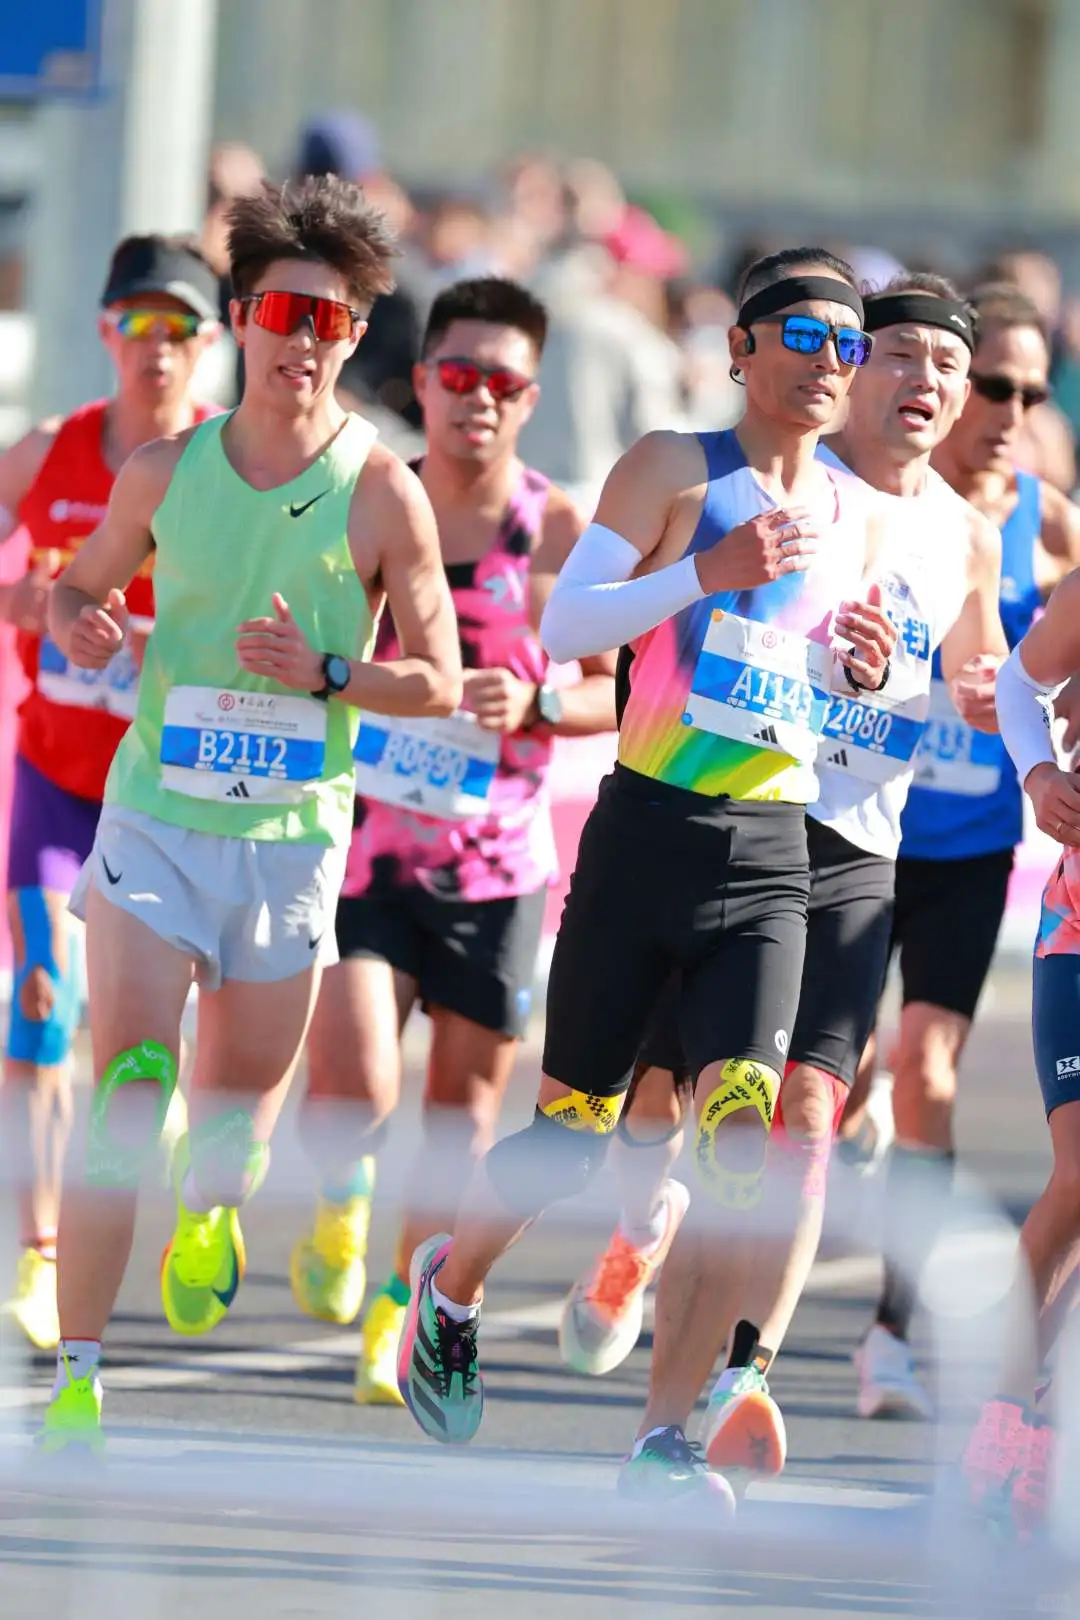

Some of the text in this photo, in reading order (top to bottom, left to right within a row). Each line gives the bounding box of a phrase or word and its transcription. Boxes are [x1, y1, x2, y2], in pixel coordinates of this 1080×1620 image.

[730, 665, 813, 720] A1143
[827, 696, 893, 744] 2080
[198, 729, 287, 771] B2112
